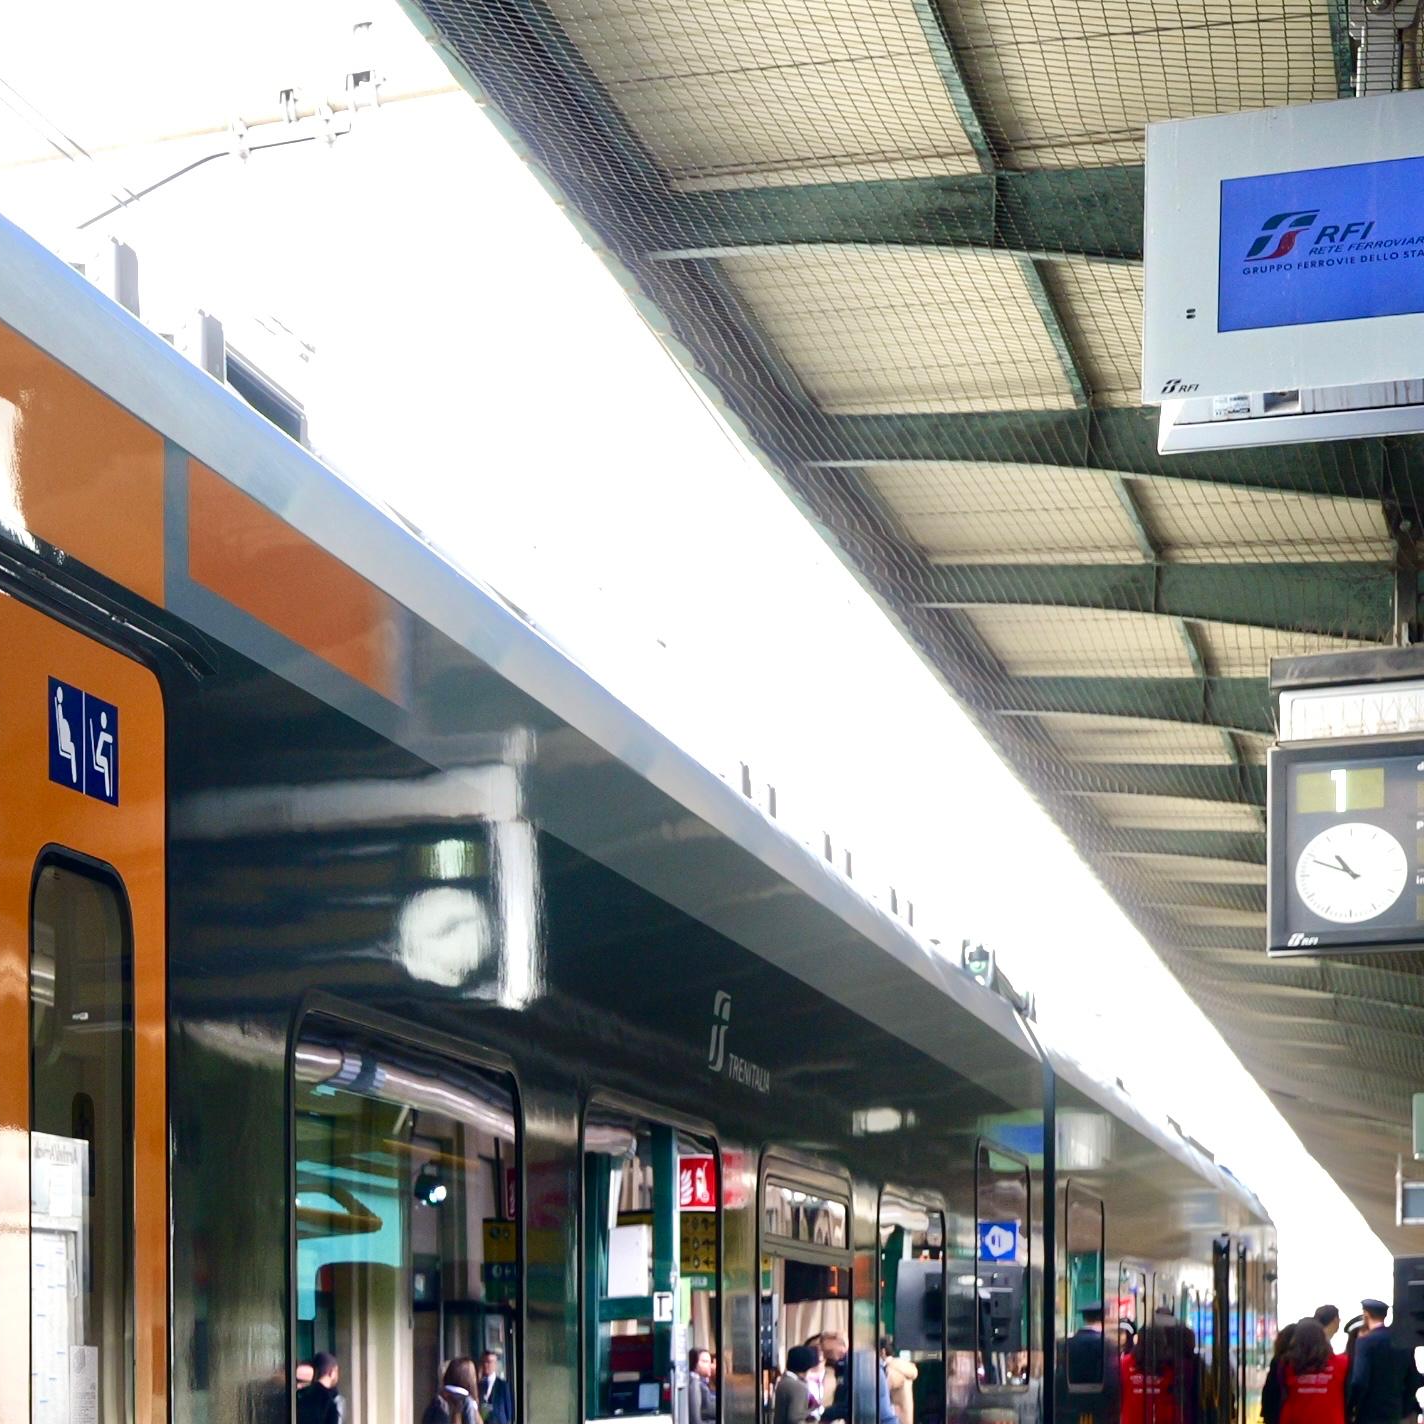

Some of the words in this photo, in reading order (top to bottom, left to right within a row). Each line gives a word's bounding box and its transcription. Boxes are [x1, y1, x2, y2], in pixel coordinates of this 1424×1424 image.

[1314, 220, 1376, 244] RFI
[1309, 244, 1345, 256] RETE
[1242, 263, 1293, 276] GRUPPO
[1297, 257, 1356, 270] FERROVIE
[1360, 250, 1399, 263] DELLO
[1178, 383, 1200, 393] RFI
[1330, 768, 1347, 813] 1
[728, 1052, 770, 1095] TRENITALIA
